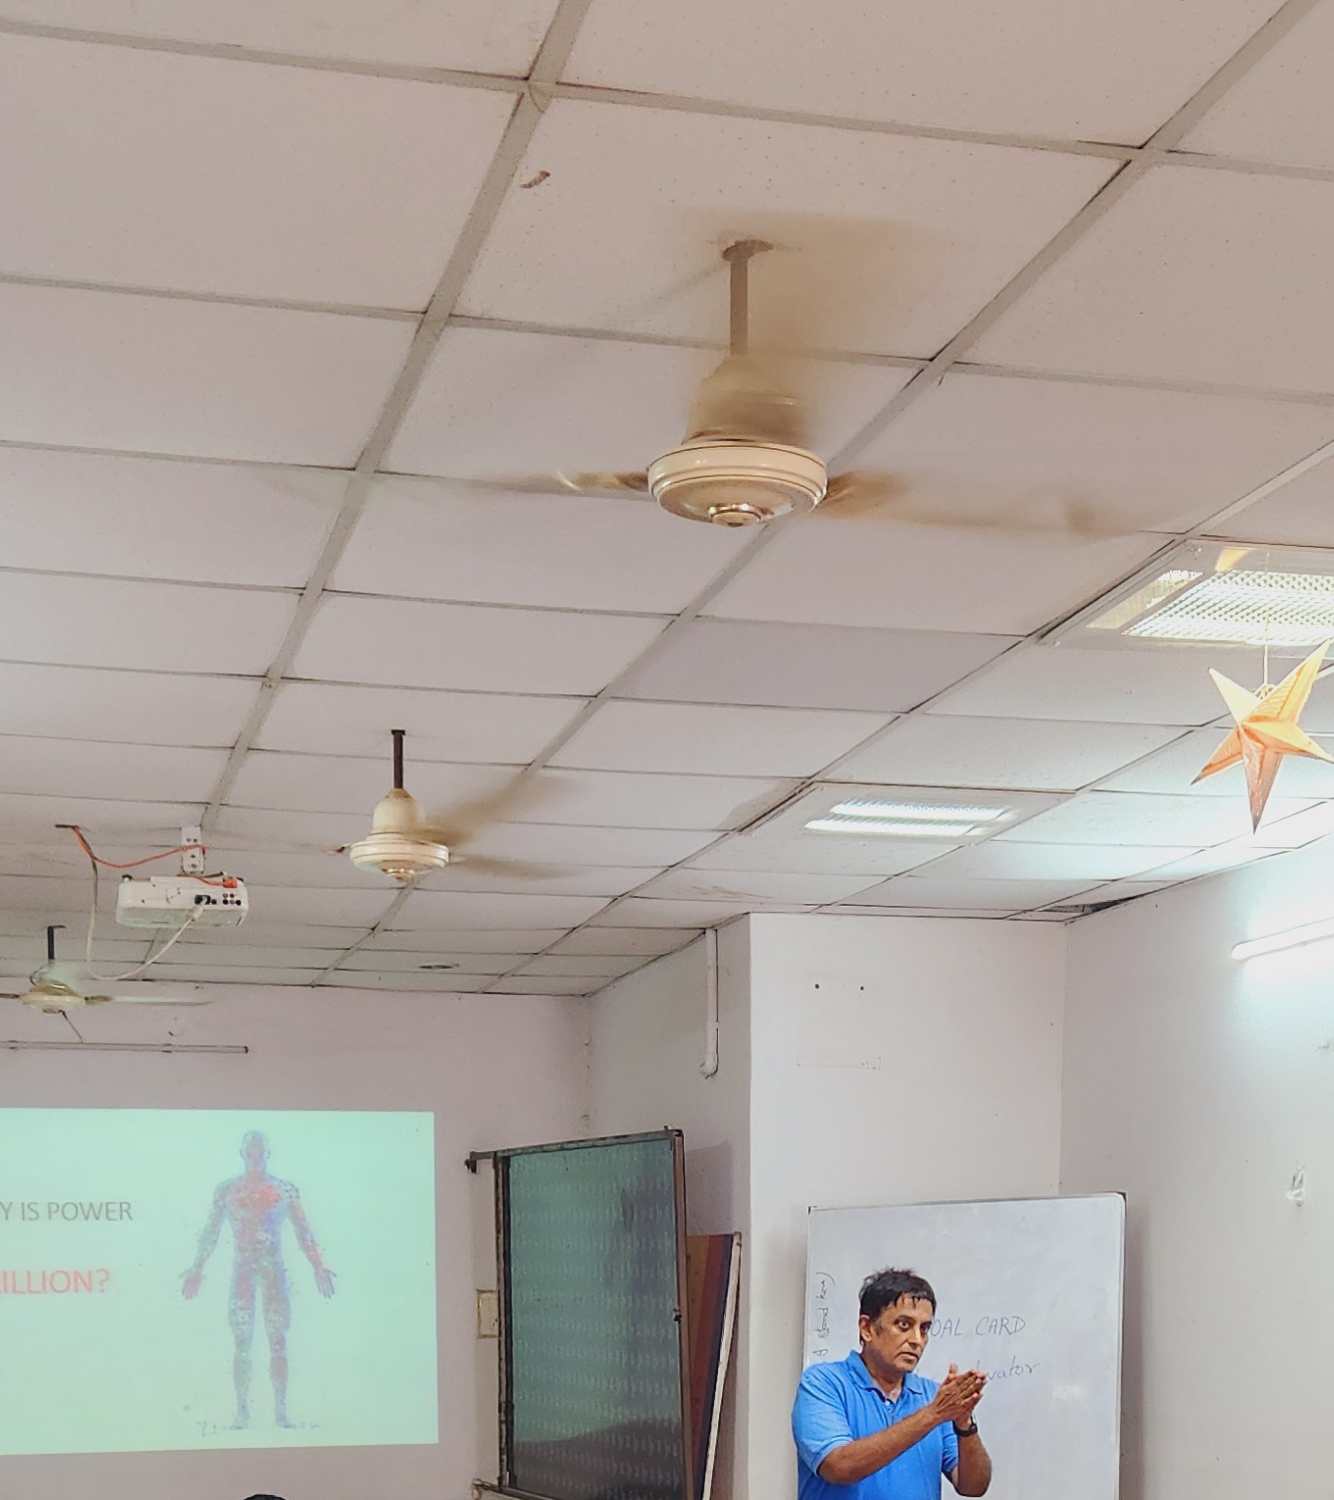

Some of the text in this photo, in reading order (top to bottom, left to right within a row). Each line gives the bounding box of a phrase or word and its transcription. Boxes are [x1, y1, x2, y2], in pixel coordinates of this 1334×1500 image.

[20, 1200, 41, 1222] IS
[47, 1200, 134, 1222] POWER
[930, 1315, 1027, 1339] OAL CARD
[984, 1354, 1041, 1381] vator
